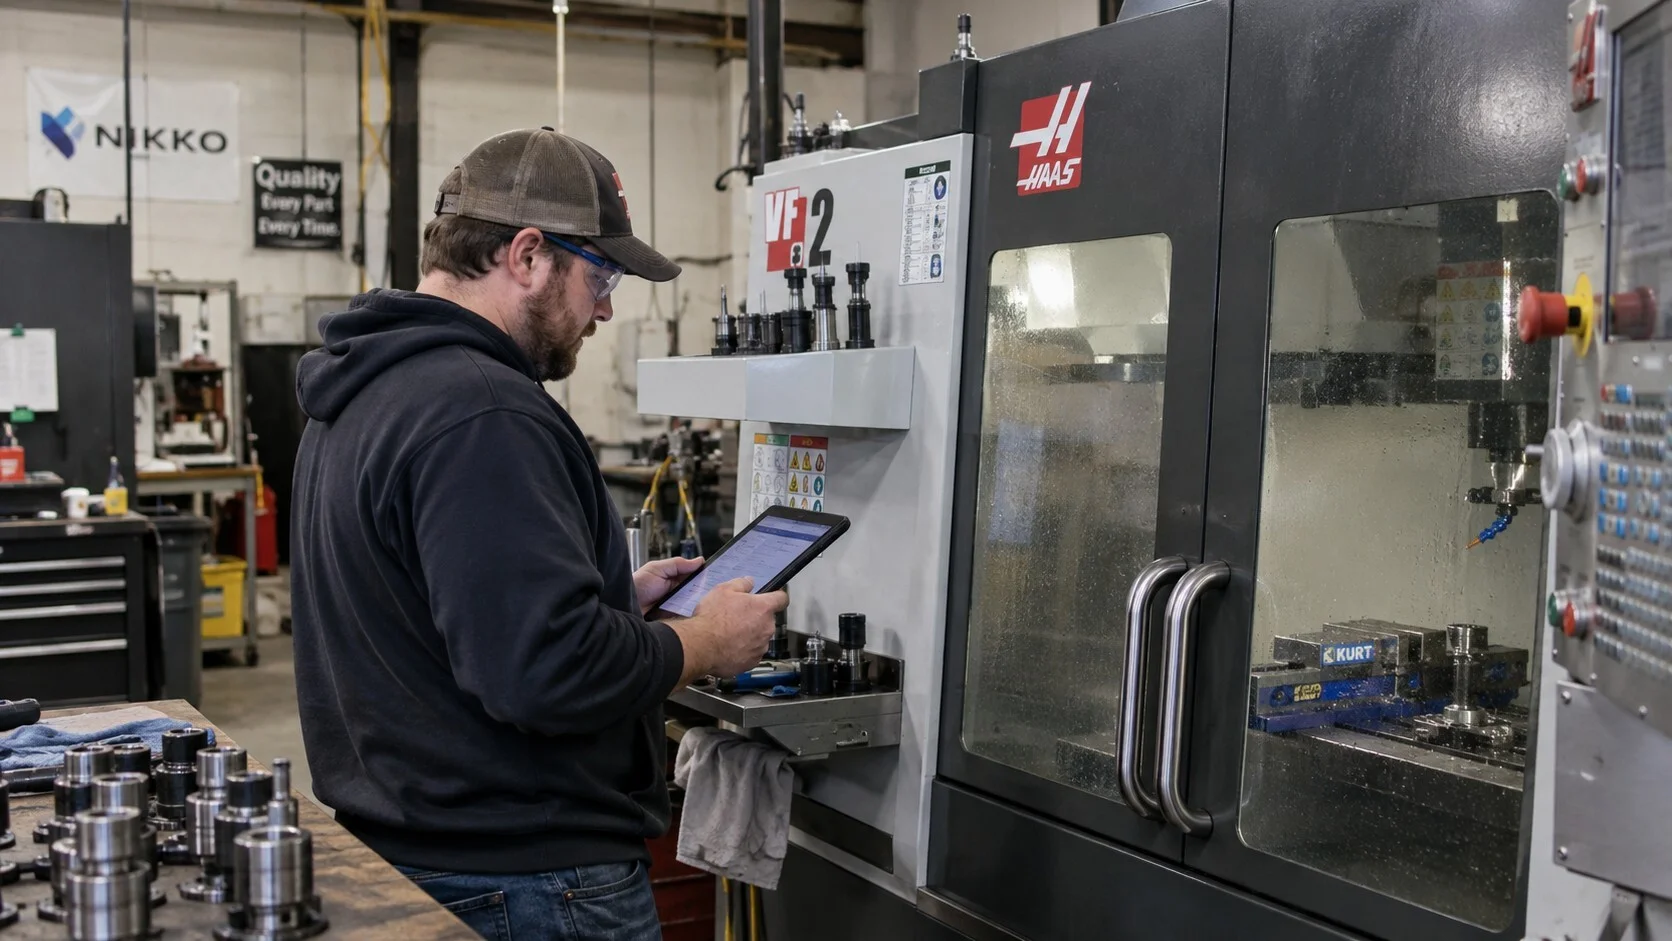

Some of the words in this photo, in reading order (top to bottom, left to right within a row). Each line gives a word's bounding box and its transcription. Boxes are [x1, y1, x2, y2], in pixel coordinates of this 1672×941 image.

[96, 125, 228, 154] NIKKO
[256, 162, 341, 195] Quality
[1016, 157, 1082, 191] HAAS
[261, 192, 302, 215] Every
[258, 216, 301, 238] Every
[1336, 645, 1373, 662] KURT
